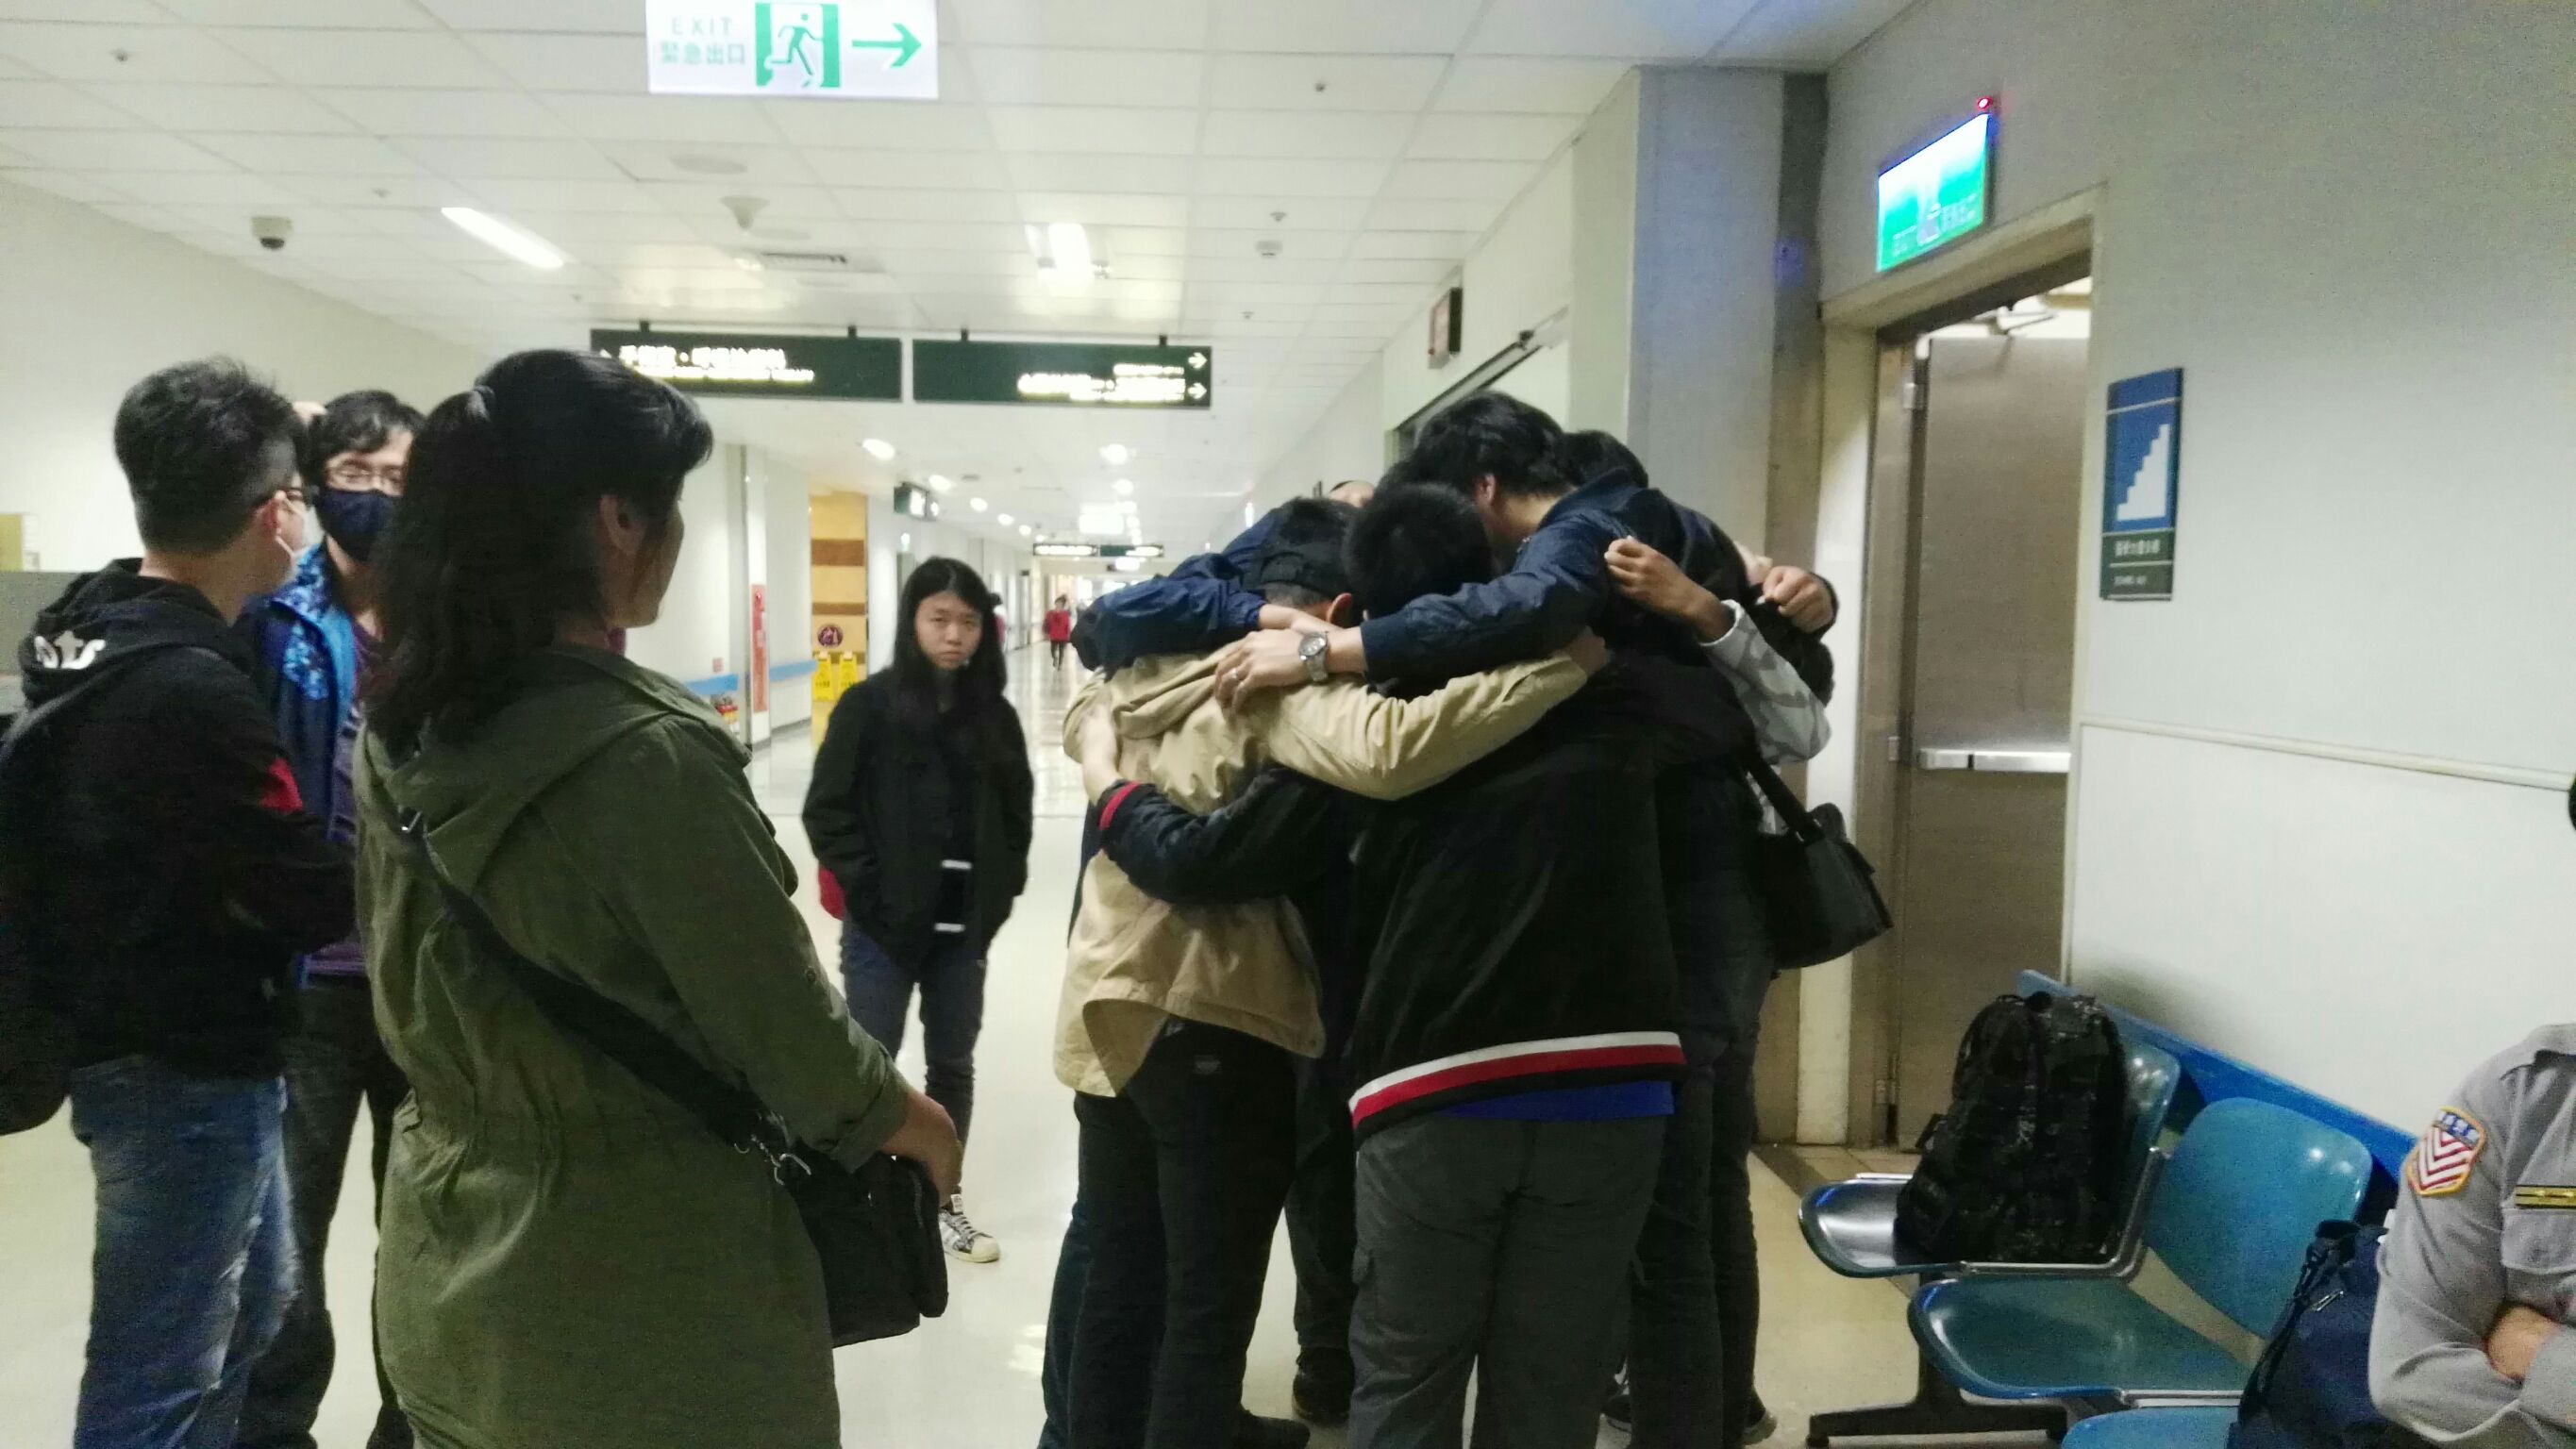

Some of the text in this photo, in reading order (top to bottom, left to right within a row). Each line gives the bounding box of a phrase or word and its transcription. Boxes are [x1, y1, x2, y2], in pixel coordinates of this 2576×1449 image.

[671, 16, 733, 36] EXIT
[660, 42, 746, 65] 緊急出口
